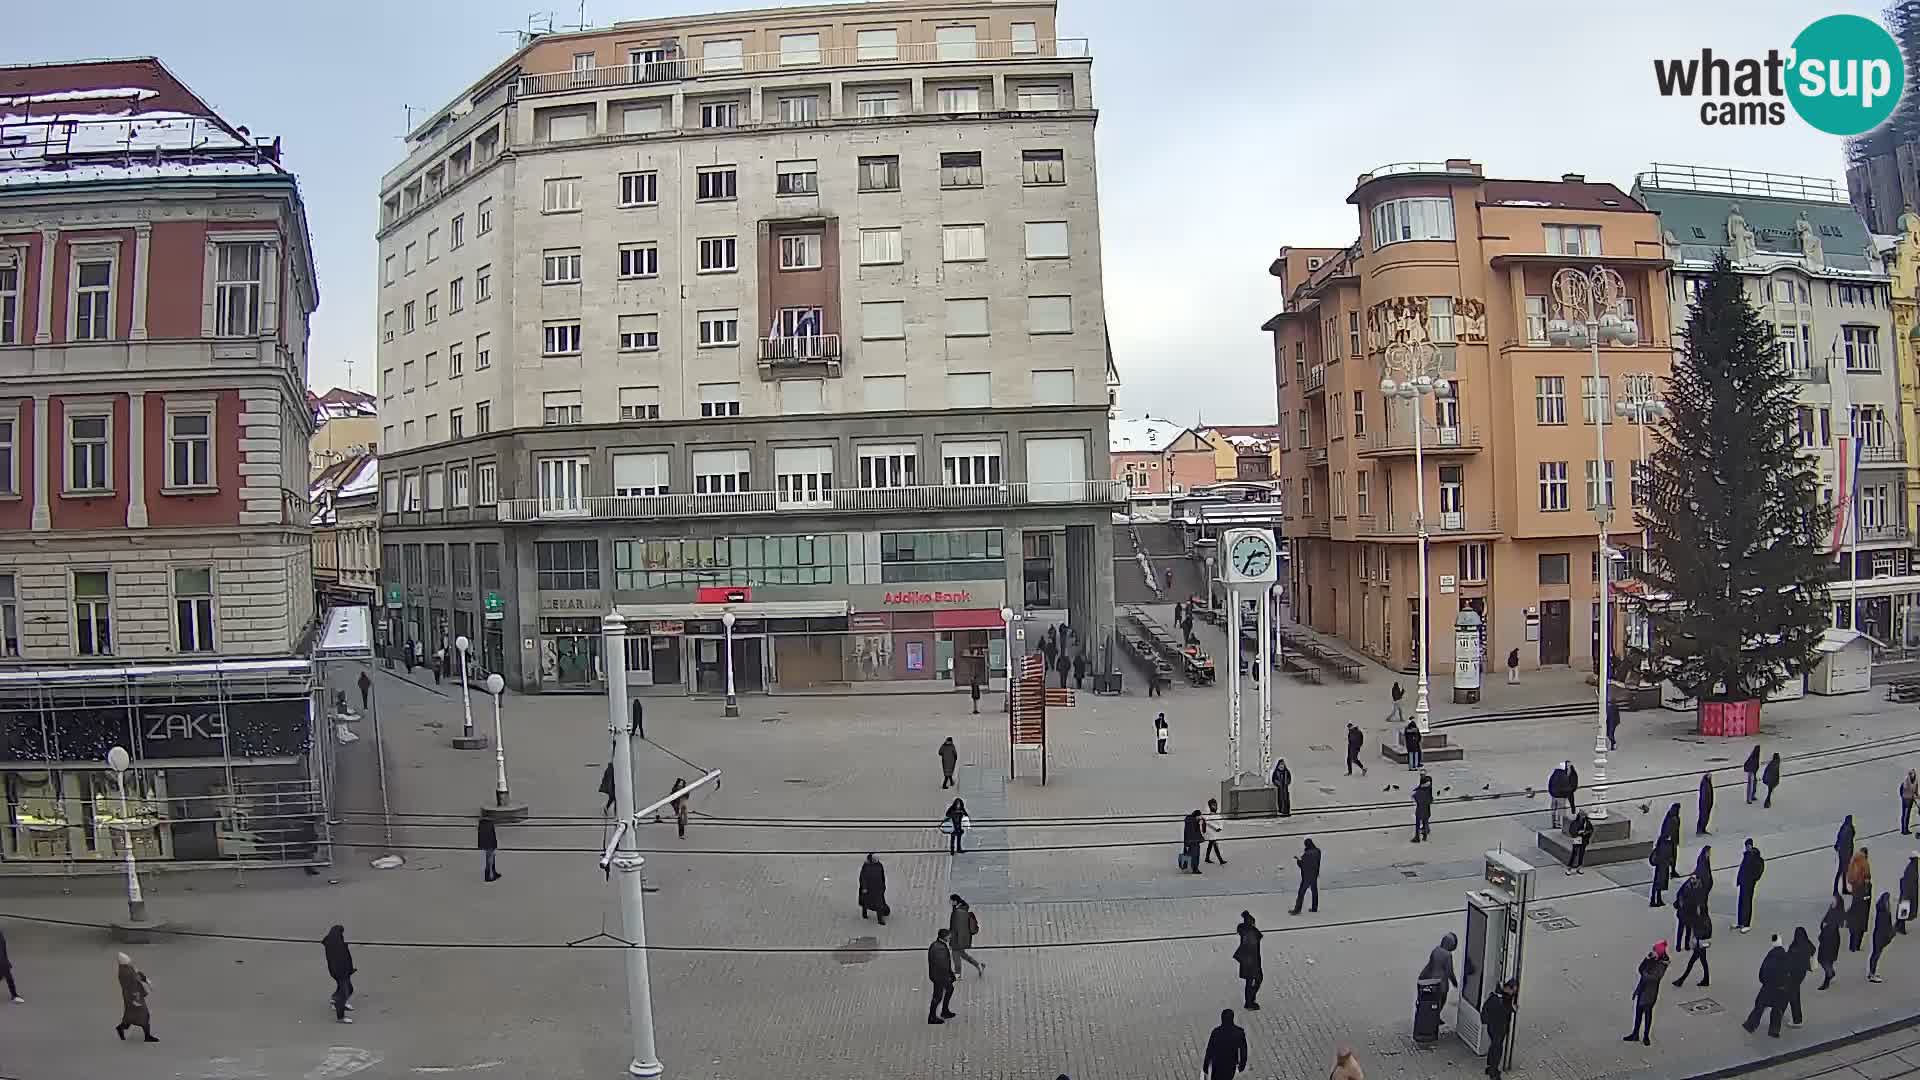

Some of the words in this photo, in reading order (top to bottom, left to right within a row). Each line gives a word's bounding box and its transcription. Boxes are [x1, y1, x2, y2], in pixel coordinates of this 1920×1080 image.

[884, 591, 932, 604] Addiko
[935, 589, 972, 603] Bank
[143, 713, 226, 740] ZAKS
